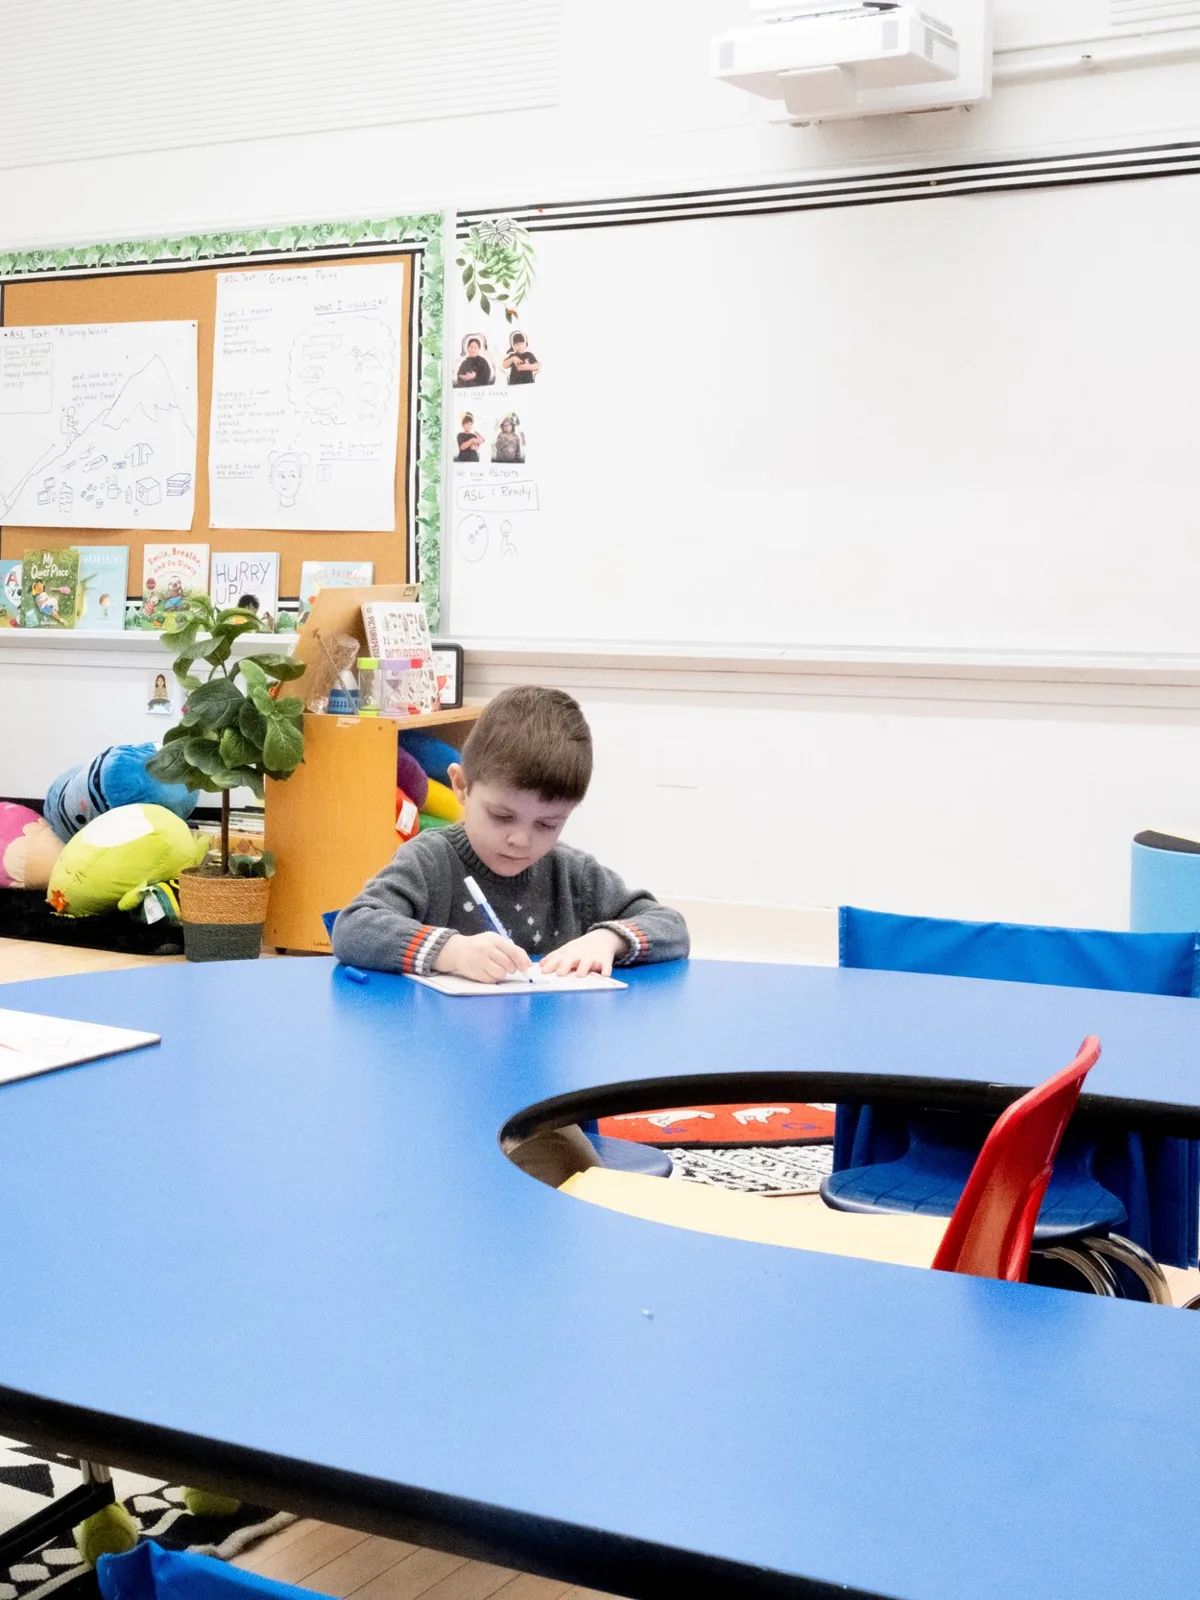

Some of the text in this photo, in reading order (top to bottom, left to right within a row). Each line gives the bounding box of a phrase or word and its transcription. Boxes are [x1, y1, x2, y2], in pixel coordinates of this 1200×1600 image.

[224, 275, 238, 283] ASL
[242, 274, 255, 282] Text
[10, 330, 25, 339] ASL
[31, 329, 48, 339] Text
[463, 486, 531, 502] ASL Ready
[43, 552, 54, 568] My
[148, 547, 201, 567] Smile, Breathe,
[31, 563, 69, 579] Quiet Place
[154, 562, 166, 574] and
[178, 560, 197, 576] Slowly
[216, 561, 271, 585] HURRY
[215, 580, 244, 605] UP!
